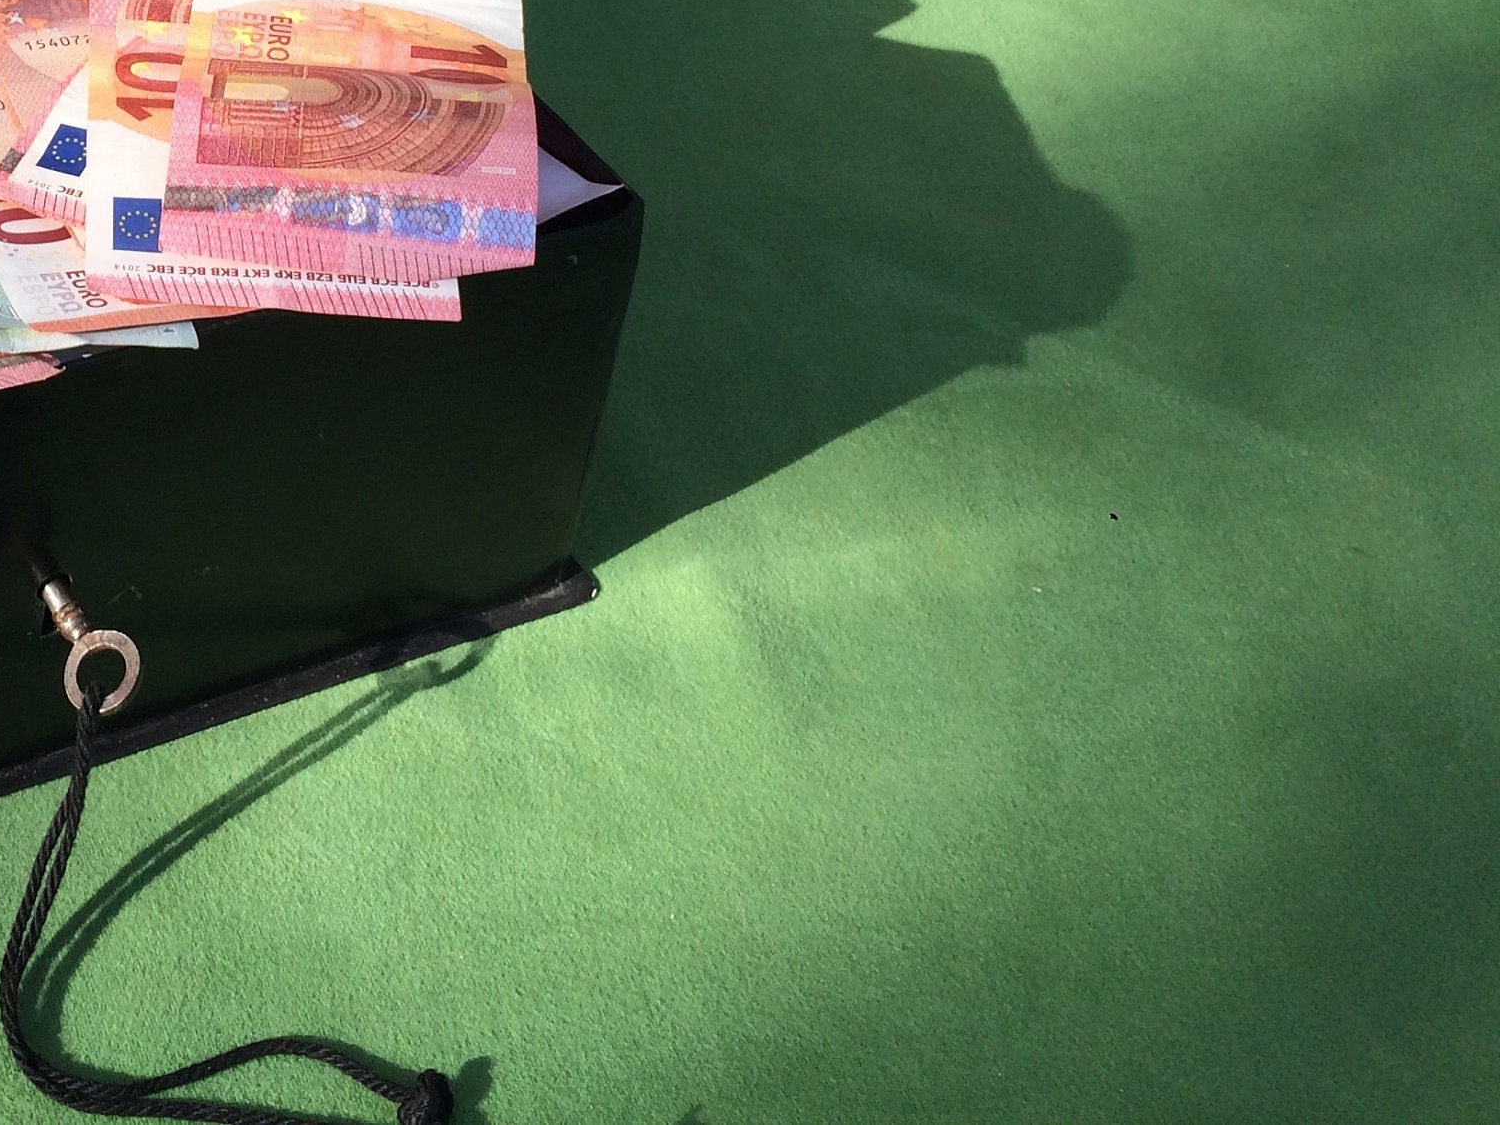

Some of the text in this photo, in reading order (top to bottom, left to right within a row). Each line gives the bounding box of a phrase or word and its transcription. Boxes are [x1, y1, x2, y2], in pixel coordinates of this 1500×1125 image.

[266, 15, 293, 61] EURO
[56, 185, 84, 198] EBC
[114, 263, 141, 272] 2014
[146, 263, 174, 274] EBC
[211, 266, 239, 277] EKB
[242, 268, 270, 278] EKT
[274, 269, 302, 280] EKP
[306, 272, 333, 282] EZB
[65, 269, 108, 308] EURO
